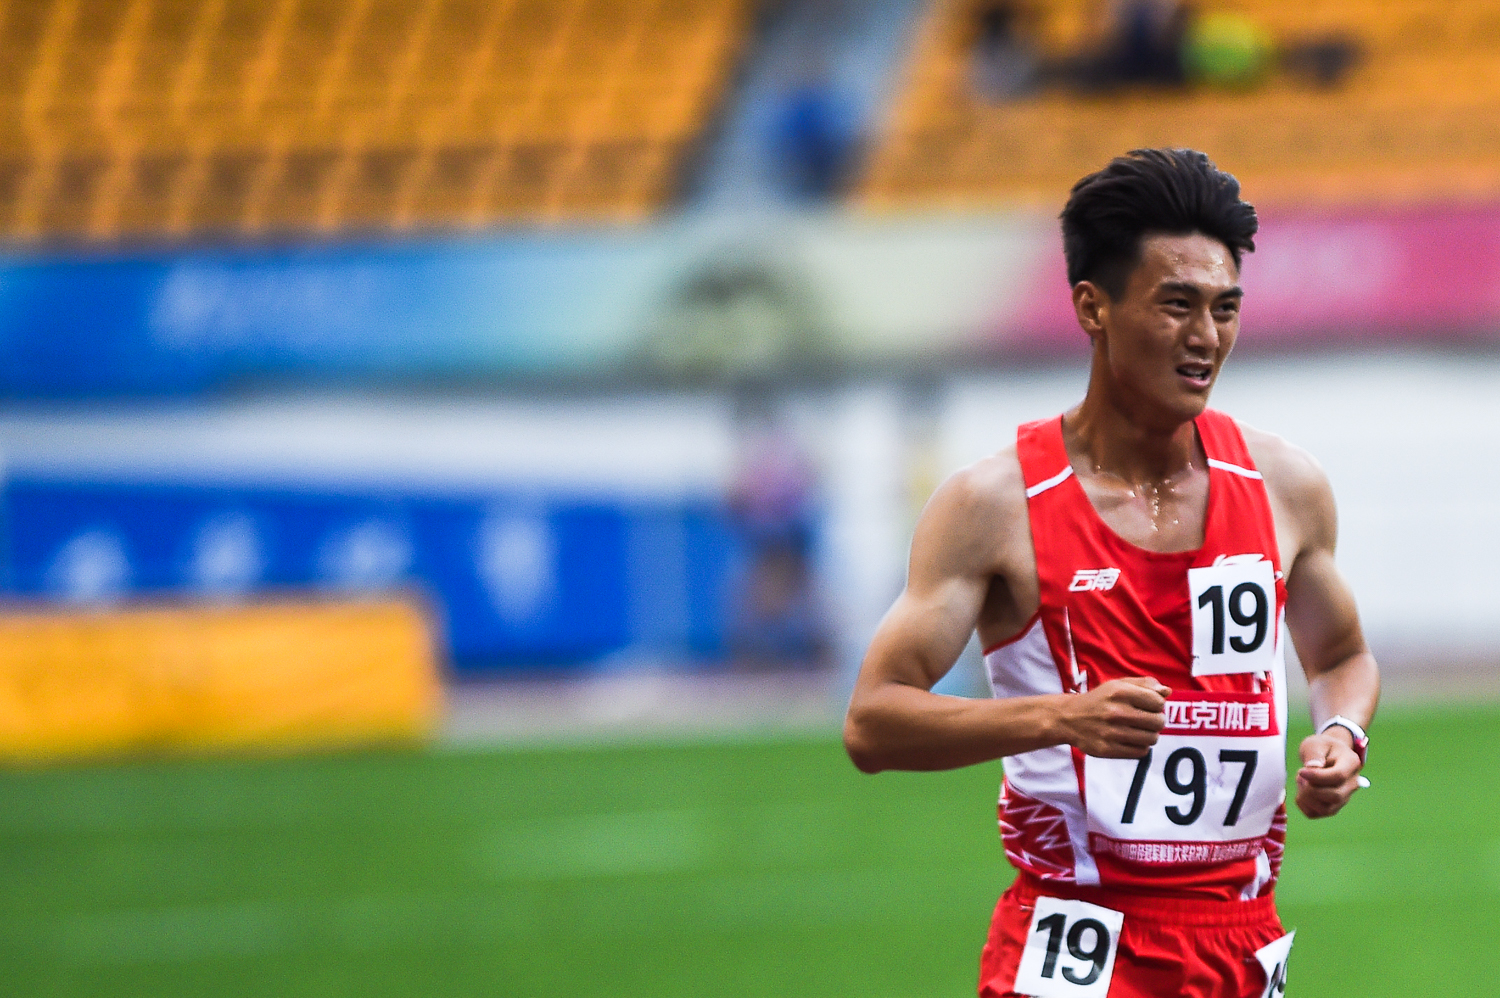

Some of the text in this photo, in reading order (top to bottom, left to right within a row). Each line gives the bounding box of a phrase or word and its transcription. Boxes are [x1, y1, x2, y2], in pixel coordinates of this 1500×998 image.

[1069, 567, 1121, 591] 云南
[1197, 581, 1269, 655] 19
[1164, 700, 1270, 731] 匹克体育
[1121, 745, 1258, 826] 797
[1036, 912, 1111, 986] 19
